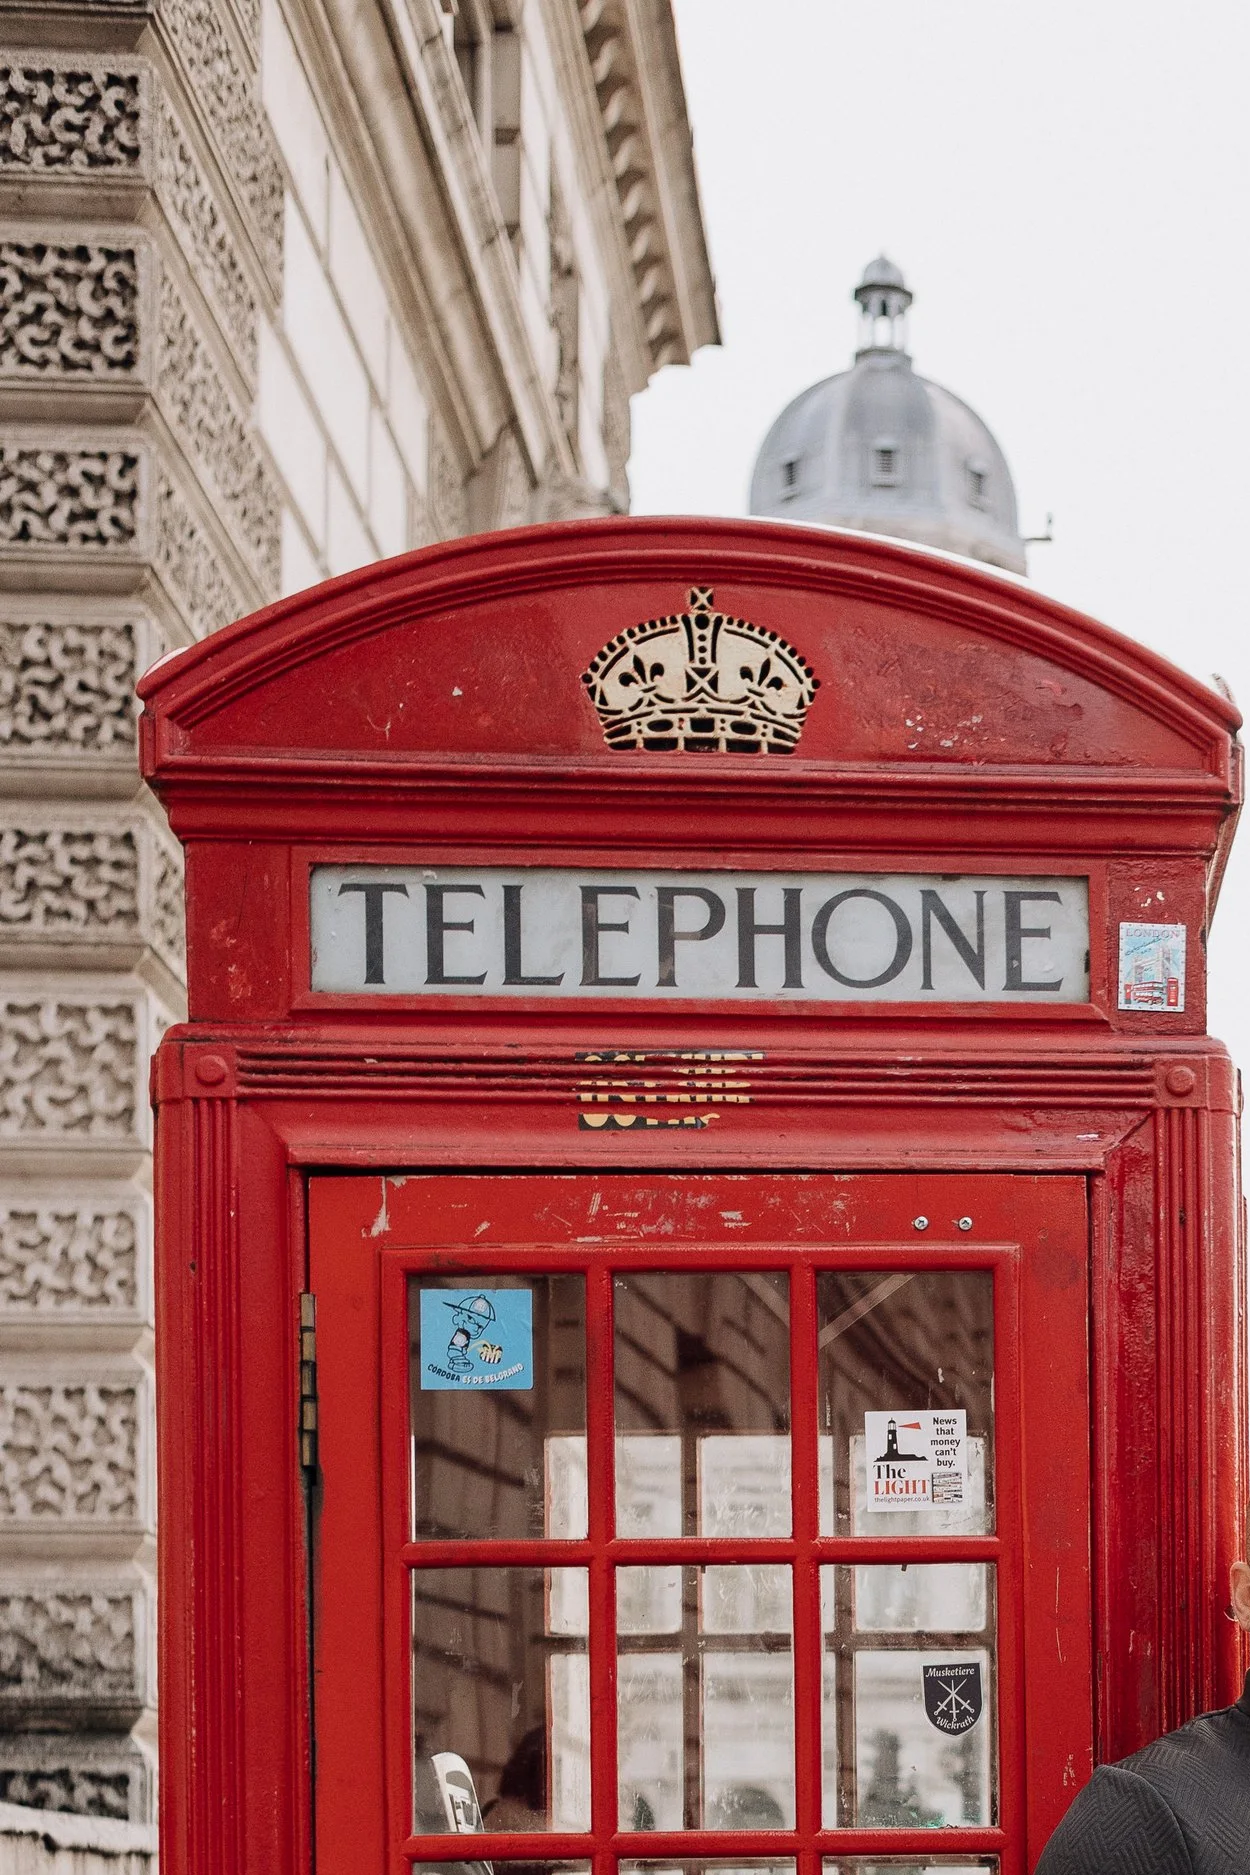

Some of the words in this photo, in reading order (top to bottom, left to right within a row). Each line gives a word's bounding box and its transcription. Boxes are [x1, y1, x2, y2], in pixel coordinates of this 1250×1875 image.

[338, 882, 1064, 993] TELEPHONE
[1126, 928, 1180, 938] LONDON
[462, 1375, 472, 1384] ES
[472, 1375, 486, 1384] DE
[486, 1363, 524, 1383] BELGRANO
[932, 1417, 958, 1425] News
[936, 1427, 955, 1435] that
[930, 1438, 961, 1448] money
[935, 1448, 957, 1456] can't
[936, 1458, 956, 1468] buy.
[873, 1464, 906, 1479] The
[874, 1480, 930, 1495] LIGHT
[874, 1496, 930, 1504] thelightpaper.co.uk
[925, 1667, 975, 1678] Musketiere
[936, 1715, 975, 1730] Wickrath
